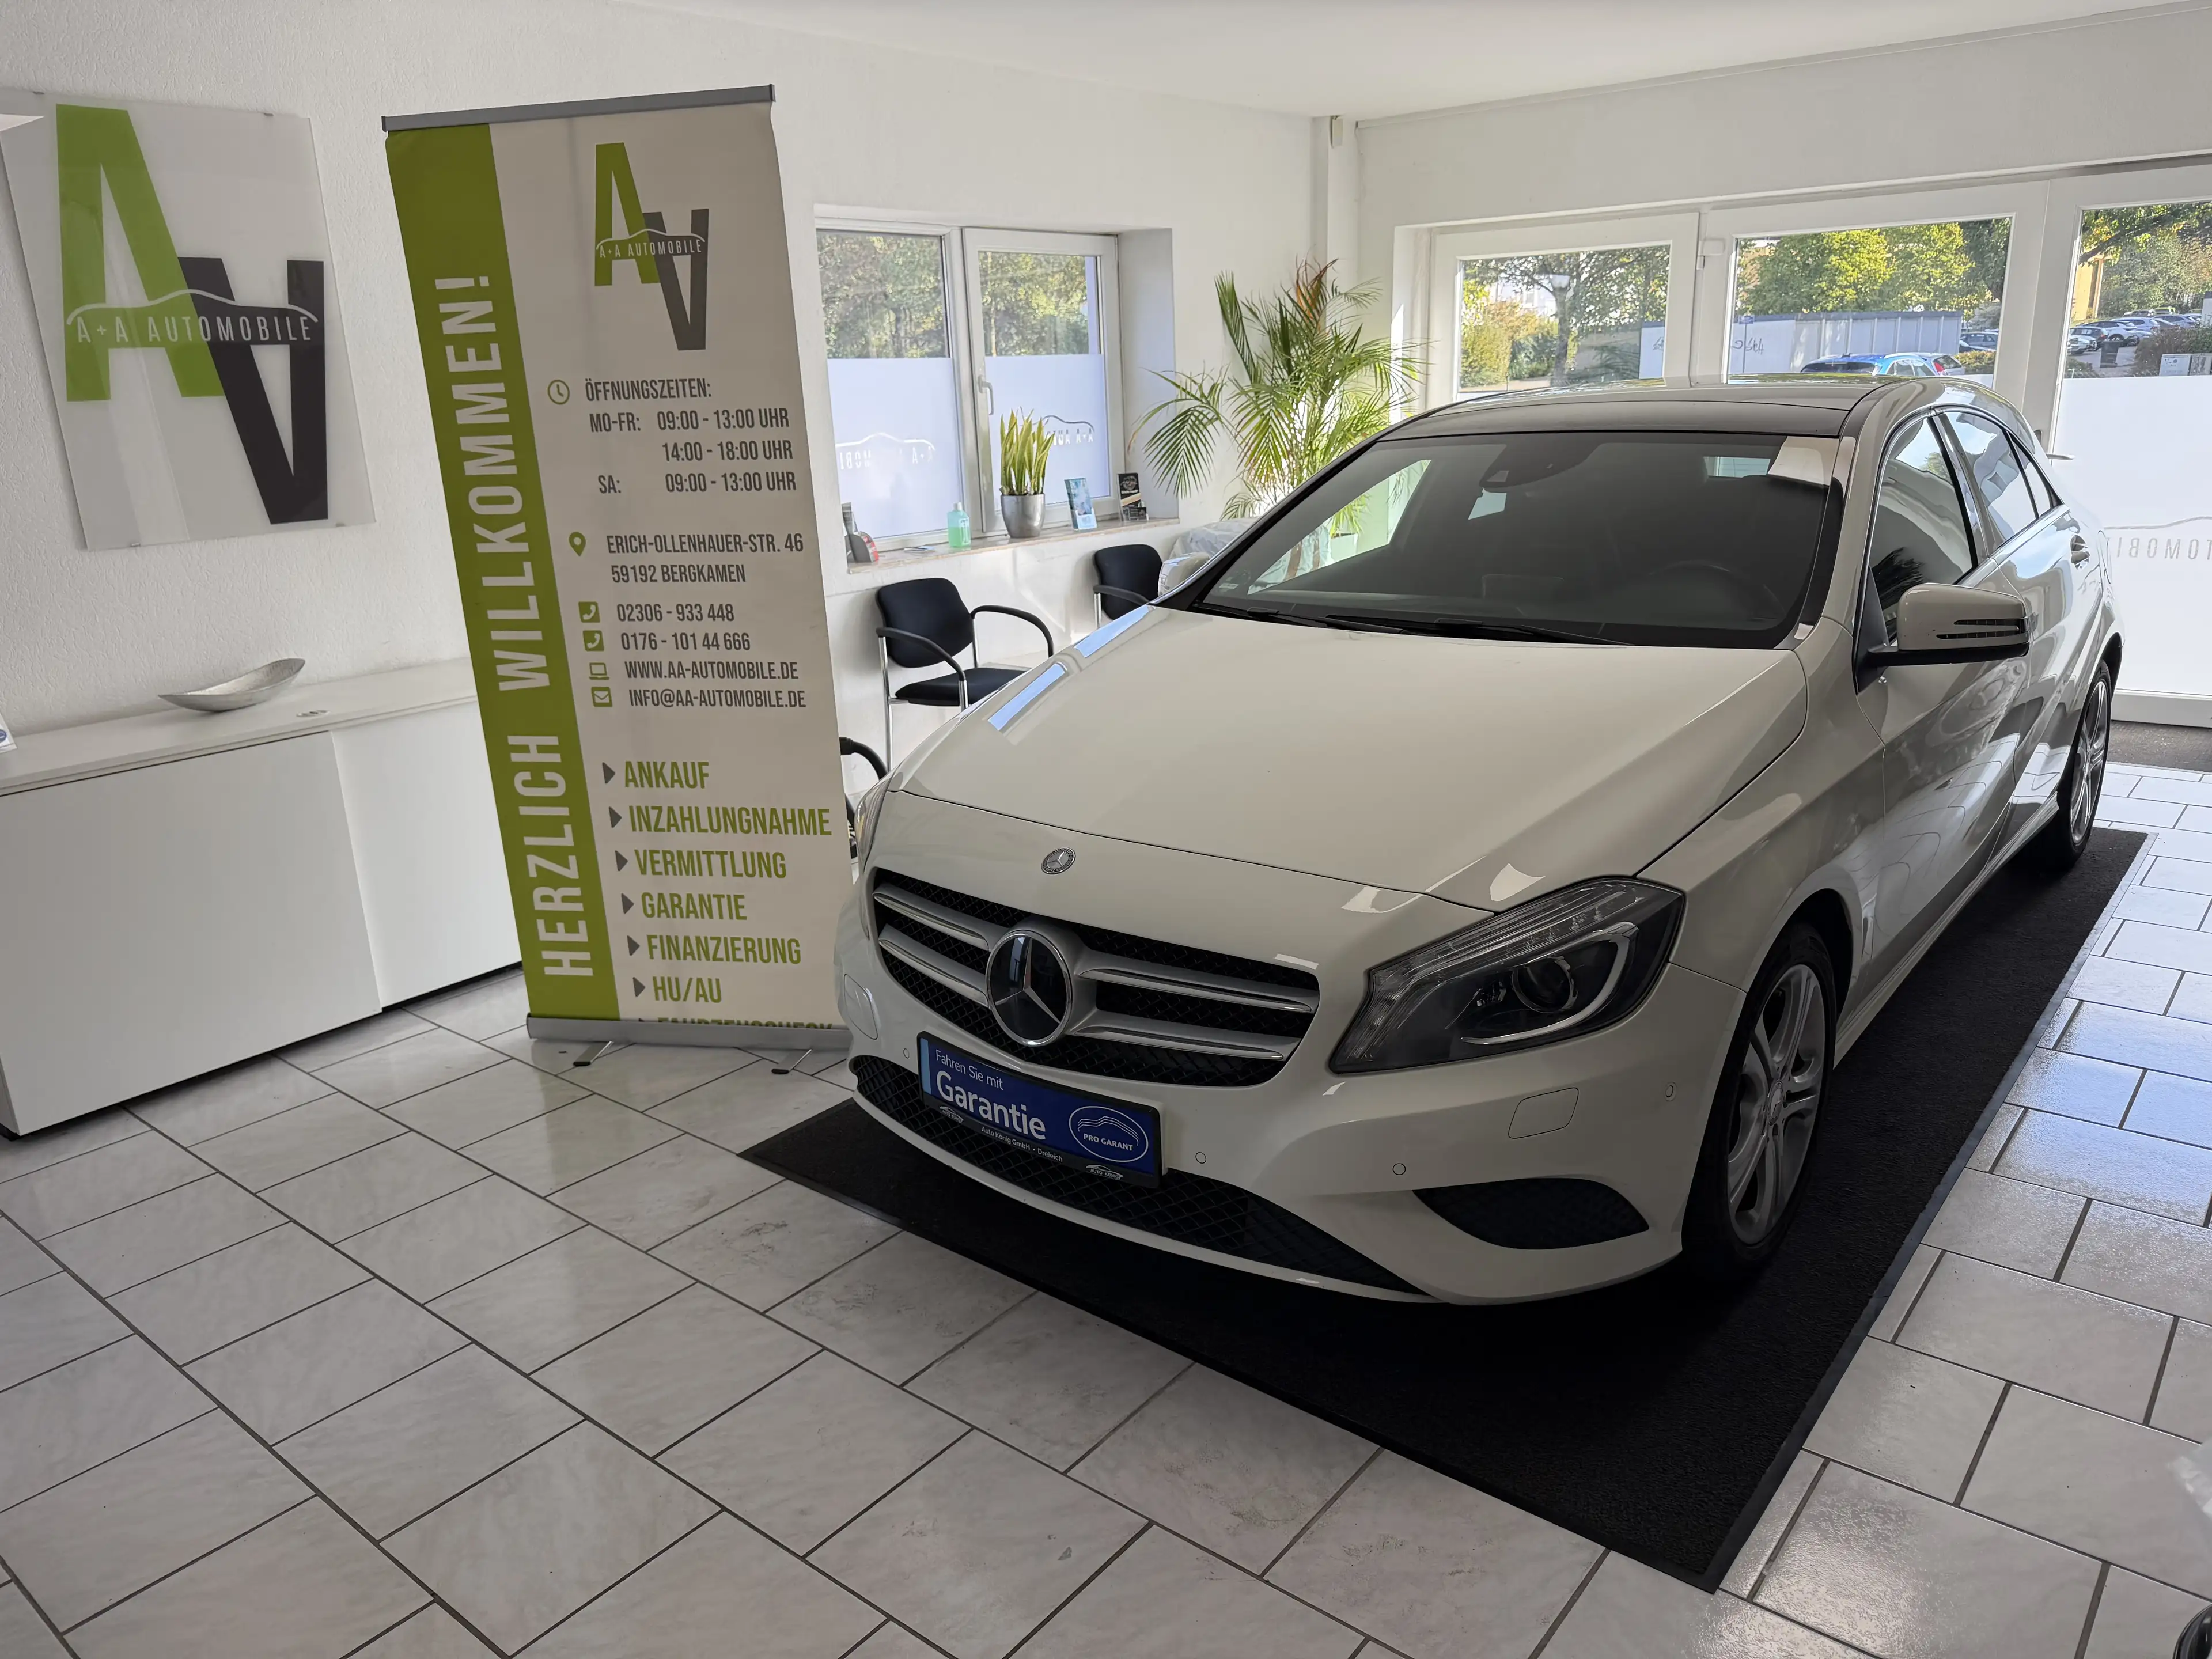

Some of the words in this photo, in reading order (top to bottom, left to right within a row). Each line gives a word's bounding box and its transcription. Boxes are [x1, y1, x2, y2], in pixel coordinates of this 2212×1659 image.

[628, 239, 702, 257] AUTOMOBILE
[148, 316, 311, 342] AUTOMOBILE
[585, 378, 712, 402] ÖFFNUNGSZEITEN:
[589, 412, 641, 433] MO-FR:
[657, 410, 699, 430] 09:00
[713, 409, 755, 429] 13:00
[758, 408, 790, 428] UHR
[662, 442, 703, 461] 14:00
[717, 441, 759, 460] 18:00
[762, 440, 793, 460] UHR
[435, 275, 550, 691] WILLKOMMEN!
[598, 475, 621, 494] SA:
[665, 473, 707, 493] 09:00
[721, 472, 762, 491] 13:00
[766, 471, 797, 491] UHR
[607, 533, 781, 554] ERICH-OLLENHAUER-STR.
[785, 533, 804, 552] 46
[611, 565, 658, 582] 59192
[661, 564, 747, 583] BERGKAMEN
[617, 604, 663, 622] 02306
[676, 603, 703, 622] 933
[707, 603, 734, 621] 448
[621, 633, 658, 650] 0176
[671, 632, 698, 650] 101
[702, 632, 720, 650] 44
[724, 632, 751, 651] 666
[624, 661, 798, 679] WWW.AA-AUTOMOBILE.DE
[630, 689, 806, 708] INFO@AA-AUTOMOBILE.DE
[624, 762, 709, 789] ANKAUF
[629, 805, 832, 836] INZAHLUNGNAHME
[507, 735, 593, 976] HERZLICH
[634, 849, 786, 878] VERMITTLUNG
[641, 892, 747, 921] GARANTIE
[646, 934, 801, 964] FINANZIERUNG
[653, 976, 722, 1003] HU/AU
[935, 1049, 966, 1075] Fahren
[969, 1066, 983, 1082] Sie
[987, 1075, 1003, 1090] mit
[937, 1070, 1046, 1140] Garantie
[982, 1126, 994, 1137] Auto
[995, 1131, 1012, 1145] König
[1012, 1139, 1031, 1151] GmbH
[1084, 1133, 1099, 1143] PRO
[1101, 1138, 1133, 1151] GARANT
